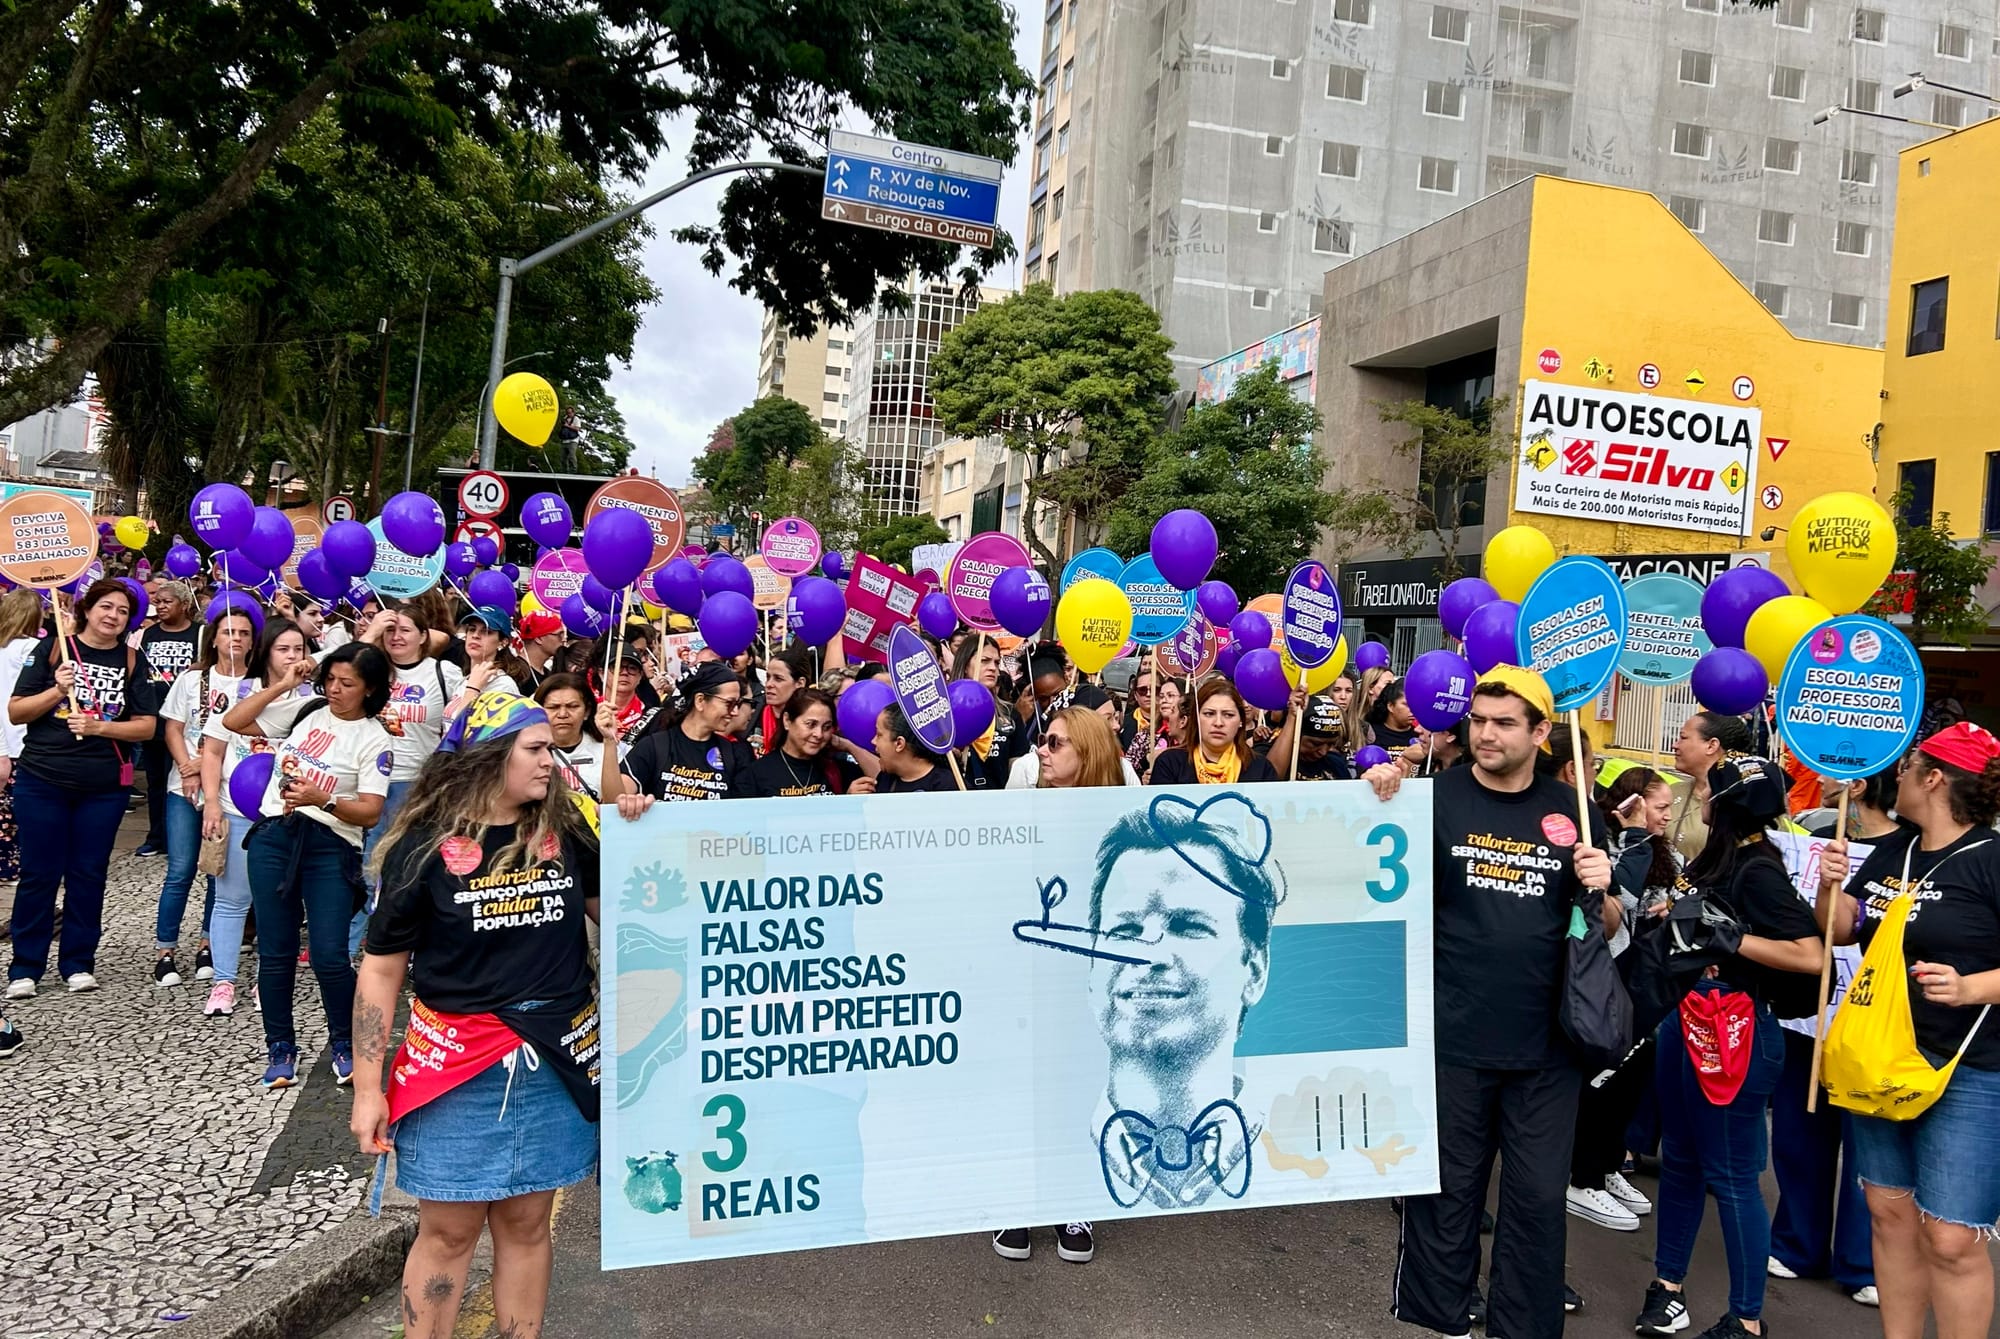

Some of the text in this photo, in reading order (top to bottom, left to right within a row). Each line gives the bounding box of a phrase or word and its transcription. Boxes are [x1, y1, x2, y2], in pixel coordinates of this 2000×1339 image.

[891, 146, 942, 167] Centro
[869, 166, 971, 198] R. XV de Nov.
[868, 184, 945, 211] Rebouças
[865, 208, 988, 243] Largo da Ordem
[1539, 356, 1560, 367] PARE
[1529, 393, 1752, 447] AUTOESCOLA
[466, 481, 499, 503] 40
[1530, 481, 1743, 514] Sua Carteira de Motorista mais Rápido.
[13, 514, 65, 525] DEVOLVA
[333, 504, 346, 521] E
[1532, 496, 1741, 529] Mais de 200.000 Motoristas Formados.
[15, 526, 67, 537] OS MEUS
[16, 538, 69, 549] 583 DIAS
[1808, 536, 1870, 553] MELHOR
[2, 548, 88, 563] TRABALHADOS
[961, 560, 986, 573] SALA
[388, 566, 431, 578] DIPLOMA
[1127, 584, 1160, 592] ESCOLA
[1362, 582, 1426, 607] TABELIONATO
[1426, 589, 1437, 604] DE
[1530, 597, 1603, 638] ESCOLA SEM
[151, 641, 193, 650] DEFESA
[1532, 616, 1608, 658] PROFESSORA
[149, 650, 192, 658] ESCOLA
[1551, 632, 1617, 666] FUNCIONA
[1625, 641, 1700, 658] EU DIPLOMA
[75, 677, 125, 691] SCOLA
[1449, 677, 1466, 694] SOU
[1807, 670, 1900, 690] ESCOLA SEM
[1801, 690, 1900, 710] PROFESSORA
[400, 705, 427, 723] CALO!
[1790, 706, 1905, 731] NÃO FUNCIONA
[300, 728, 336, 758] SOU
[282, 743, 331, 771] professor
[661, 772, 695, 786] SERVIÇO
[715, 773, 722, 781] O
[665, 783, 720, 800] É cuidar DA
[700, 825, 1044, 859] REPÚBLICA FEDERATIVA DO BRASIL
[1467, 832, 1549, 856] valorizar O
[1365, 823, 1410, 903] 3
[1451, 845, 1562, 871] SERVIÇO PÚBLICO
[469, 868, 558, 890] valorizar O
[1466, 860, 1546, 884] É cuidar DA
[453, 876, 573, 904] SERVIÇO PÚBLICO
[641, 880, 659, 907] 3
[700, 872, 884, 914] VALOR DAS
[1466, 876, 1544, 898] POPULAÇÃO
[472, 895, 565, 917] É cuidar DA
[473, 908, 564, 932] POPULAÇÃO
[701, 916, 825, 956] FALSAS
[701, 952, 907, 999] PROMESSAS
[701, 990, 962, 1041] DE UM PREFEITO
[447, 1028, 457, 1038] O
[432, 1047, 447, 1062] DA
[701, 1032, 959, 1084] DESPREPARADO
[702, 1093, 748, 1173] 3
[702, 1173, 821, 1222] REAIS
